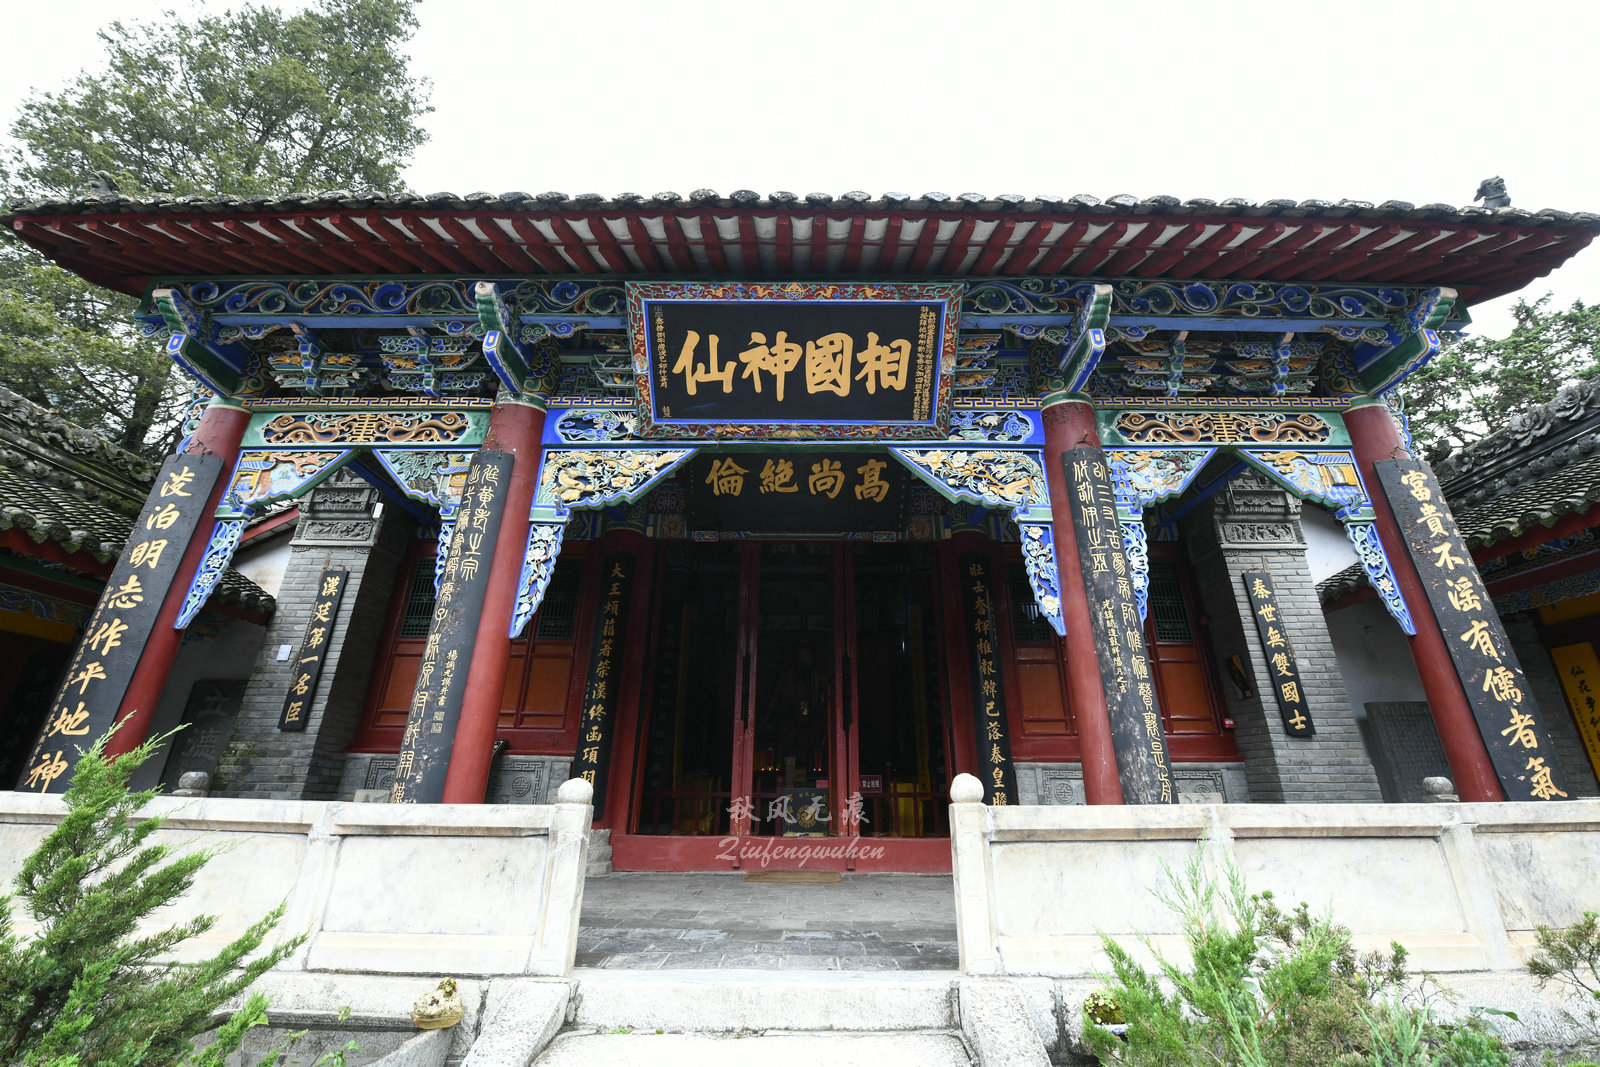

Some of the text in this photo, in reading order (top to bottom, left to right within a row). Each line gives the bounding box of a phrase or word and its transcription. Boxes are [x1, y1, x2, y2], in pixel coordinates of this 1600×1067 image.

[672, 330, 912, 402] 相國神仙
[285, 575, 341, 724] 漢廷第一名臣
[1252, 577, 1307, 731] 秦世無雙國士
